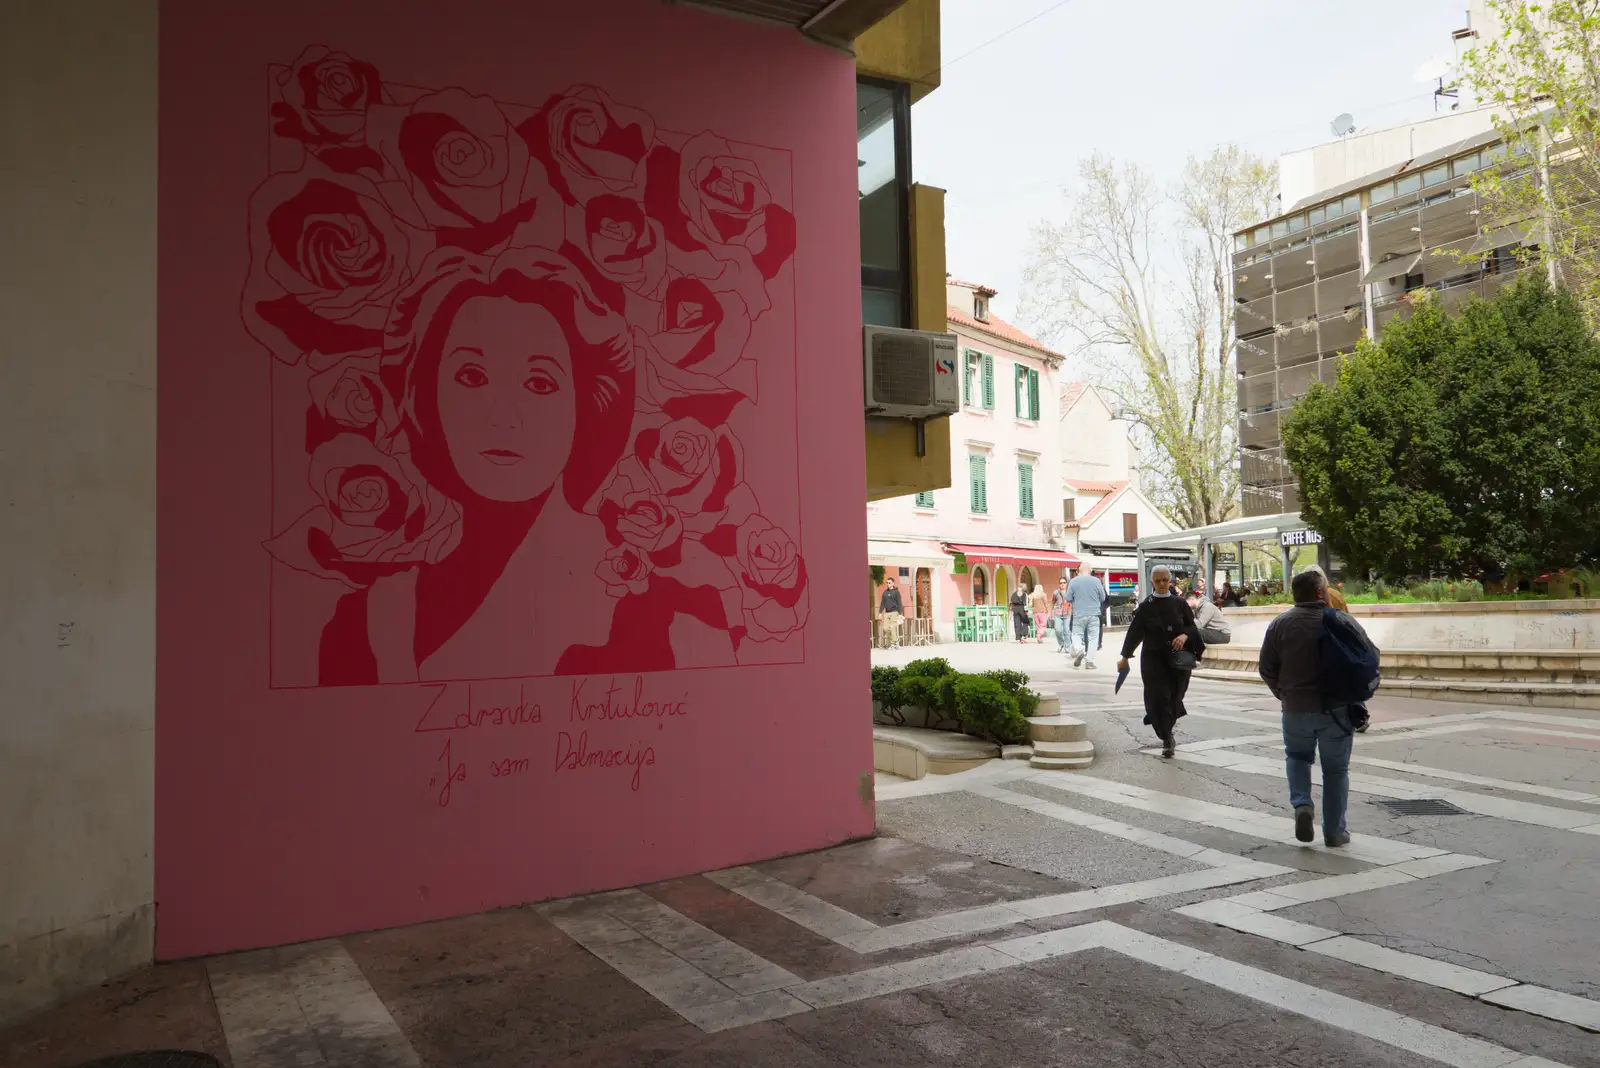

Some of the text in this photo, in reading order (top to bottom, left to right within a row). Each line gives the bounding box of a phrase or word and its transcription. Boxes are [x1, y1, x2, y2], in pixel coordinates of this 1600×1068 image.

[1281, 531, 1305, 545] CAFFE
[414, 675, 689, 732] Zdravka Krstulović
[490, 756, 529, 777] sam
